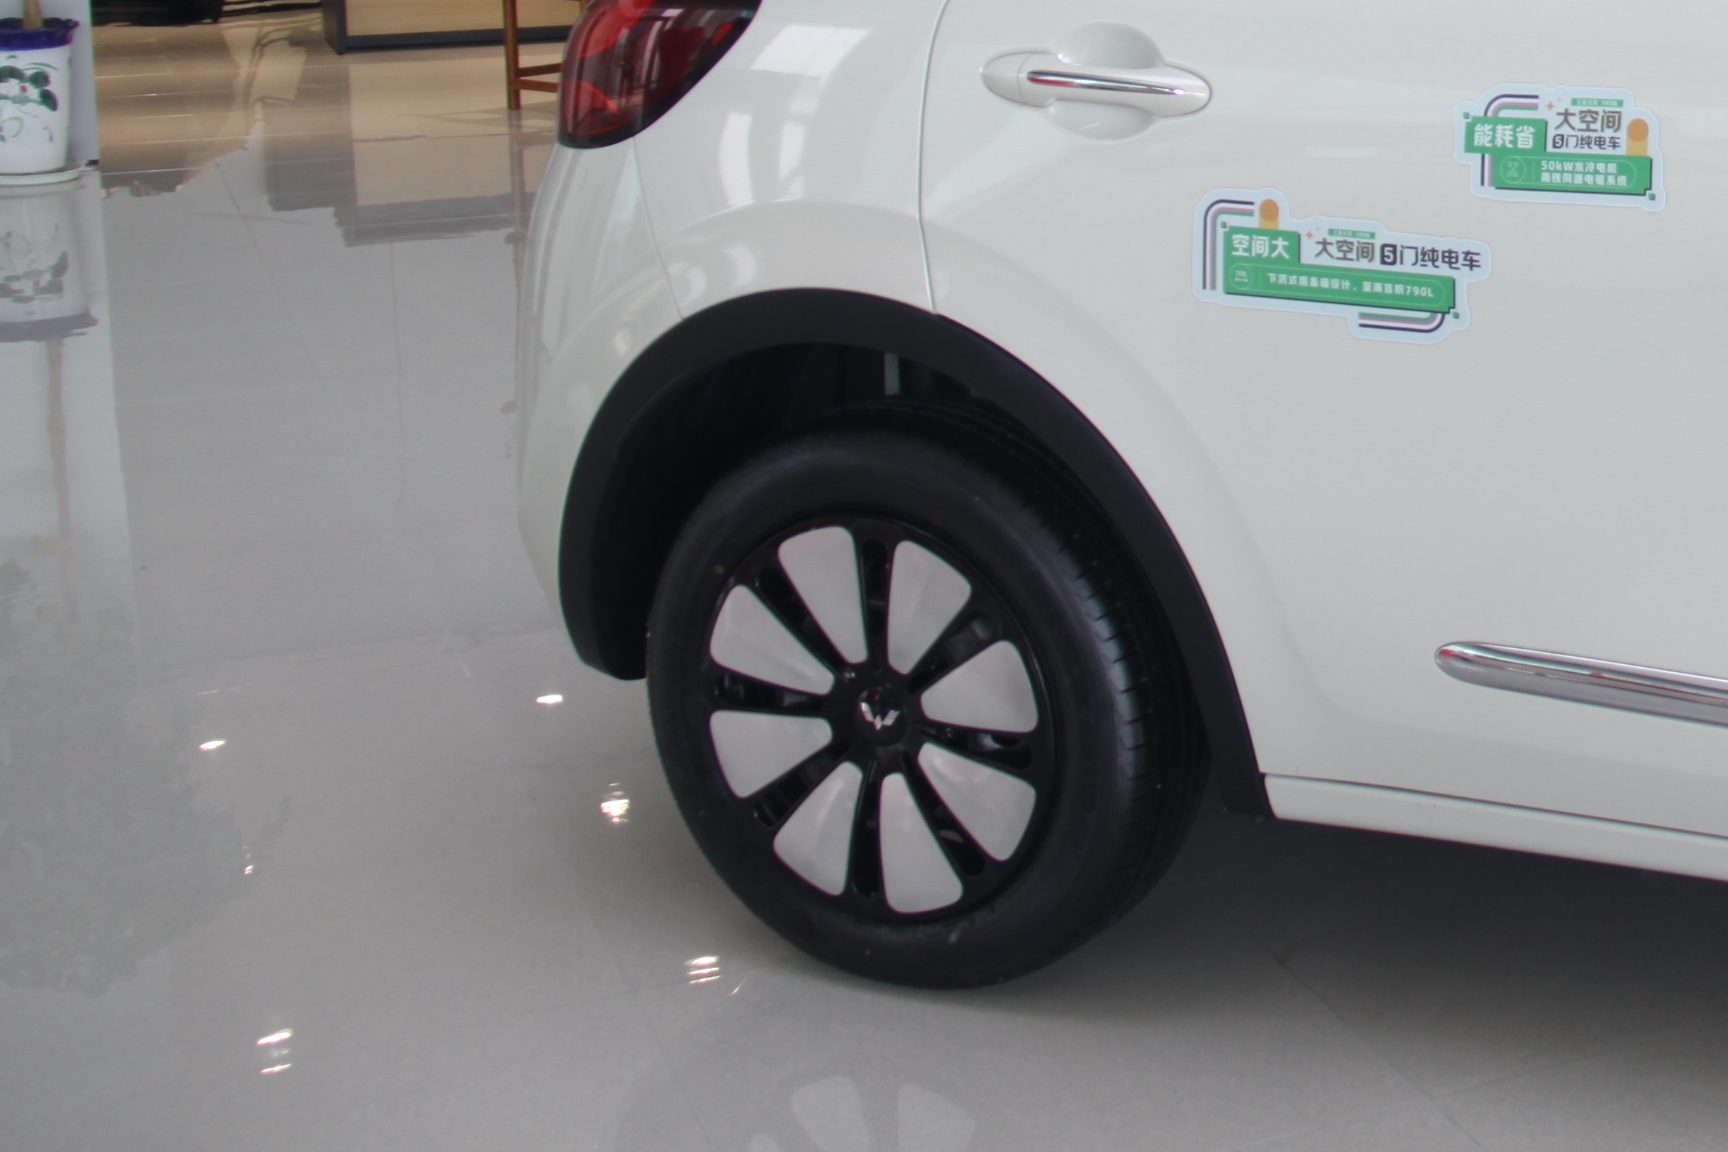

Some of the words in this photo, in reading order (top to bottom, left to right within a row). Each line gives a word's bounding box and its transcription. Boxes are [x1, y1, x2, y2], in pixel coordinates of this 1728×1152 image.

[1554, 108, 1622, 133] 大空间
[1473, 123, 1535, 148] 能耗省
[1552, 133, 1621, 150] 5门纯电车
[1231, 233, 1290, 259] 空间大
